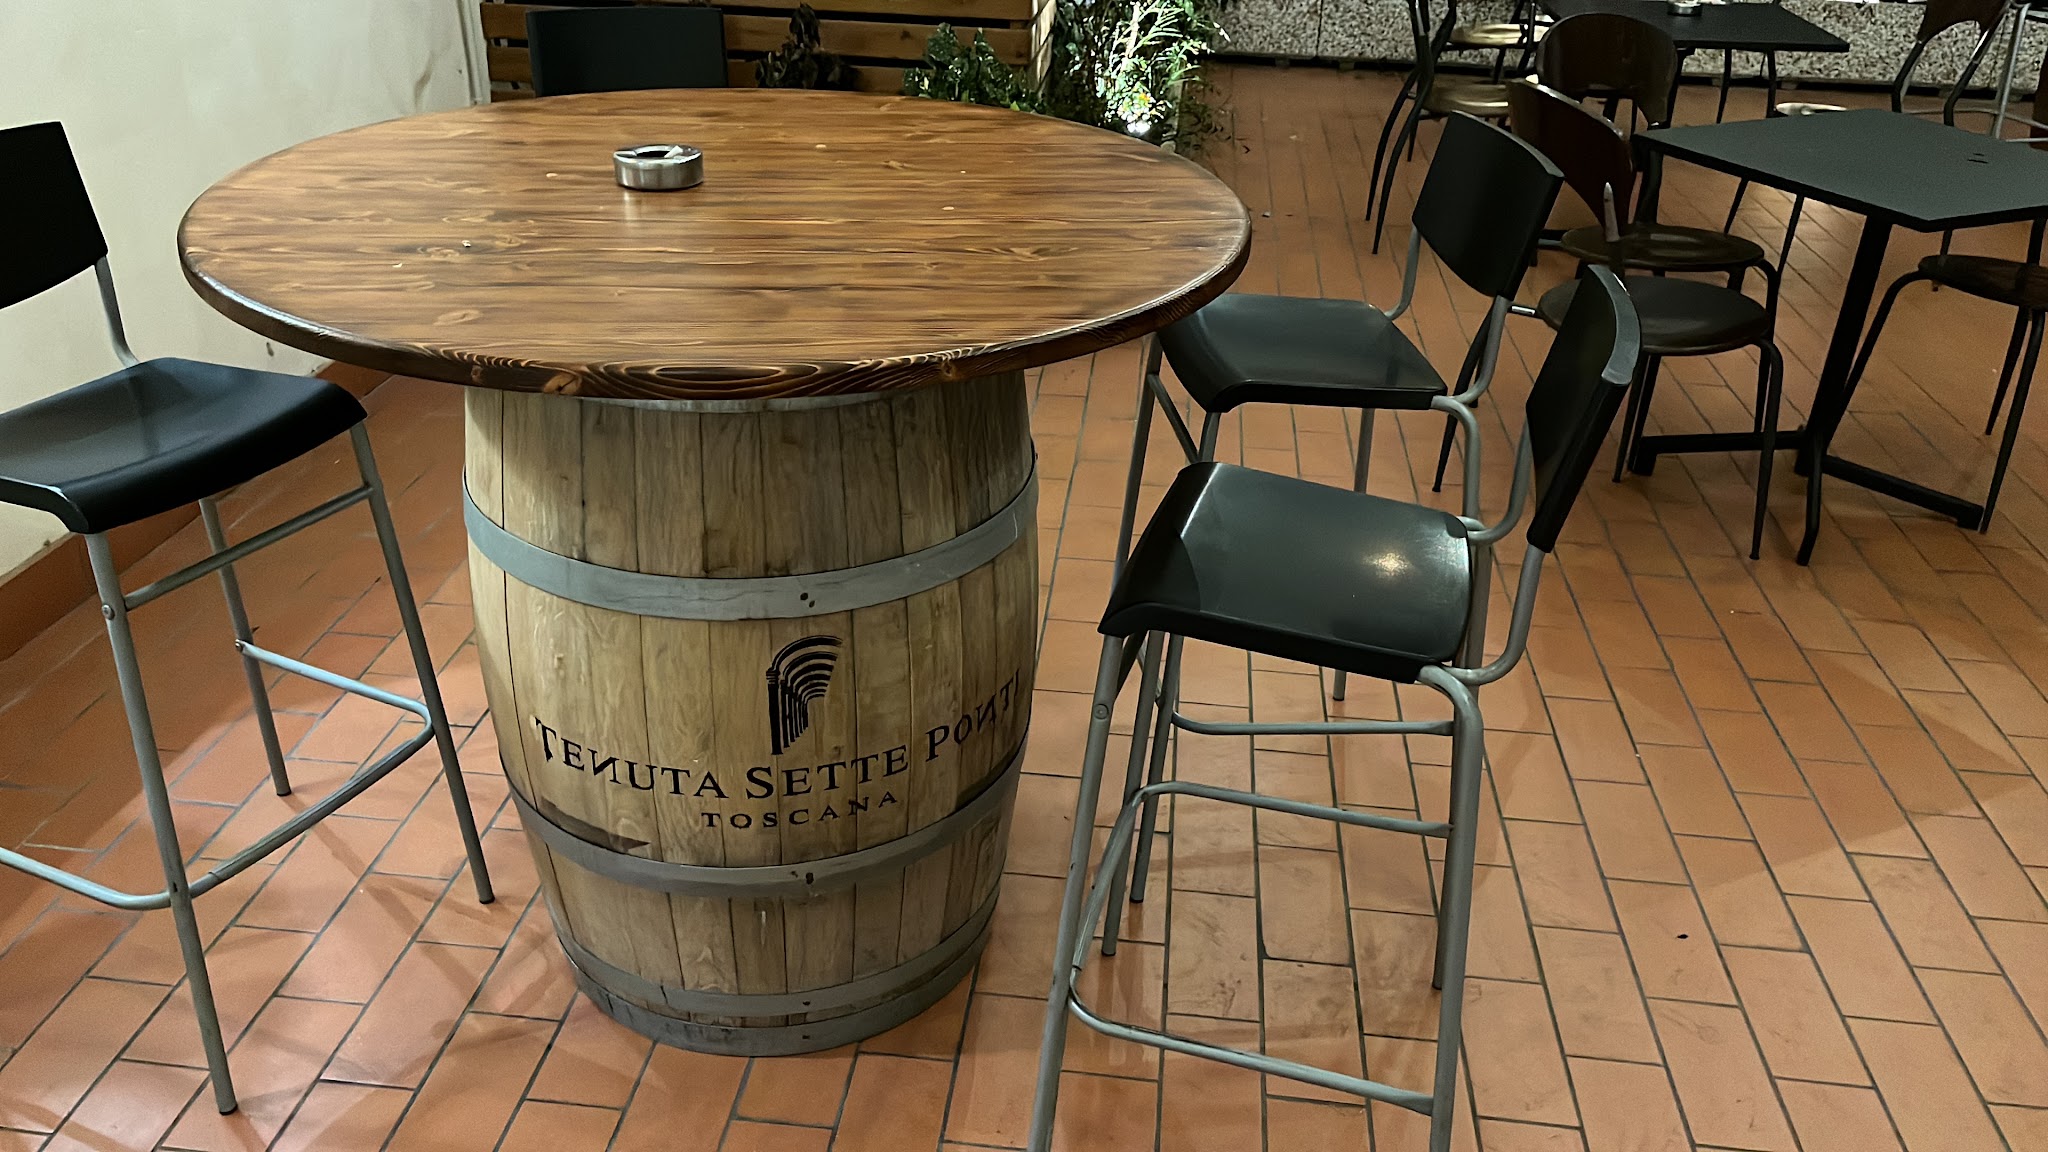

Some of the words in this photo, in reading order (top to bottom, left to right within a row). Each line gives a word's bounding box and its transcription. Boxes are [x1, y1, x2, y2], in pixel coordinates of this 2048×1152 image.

[535, 716, 729, 799] TENUTA
[746, 744, 908, 799] SETTE
[925, 667, 1020, 762] PONTI
[701, 791, 898, 829] TOSCANA
